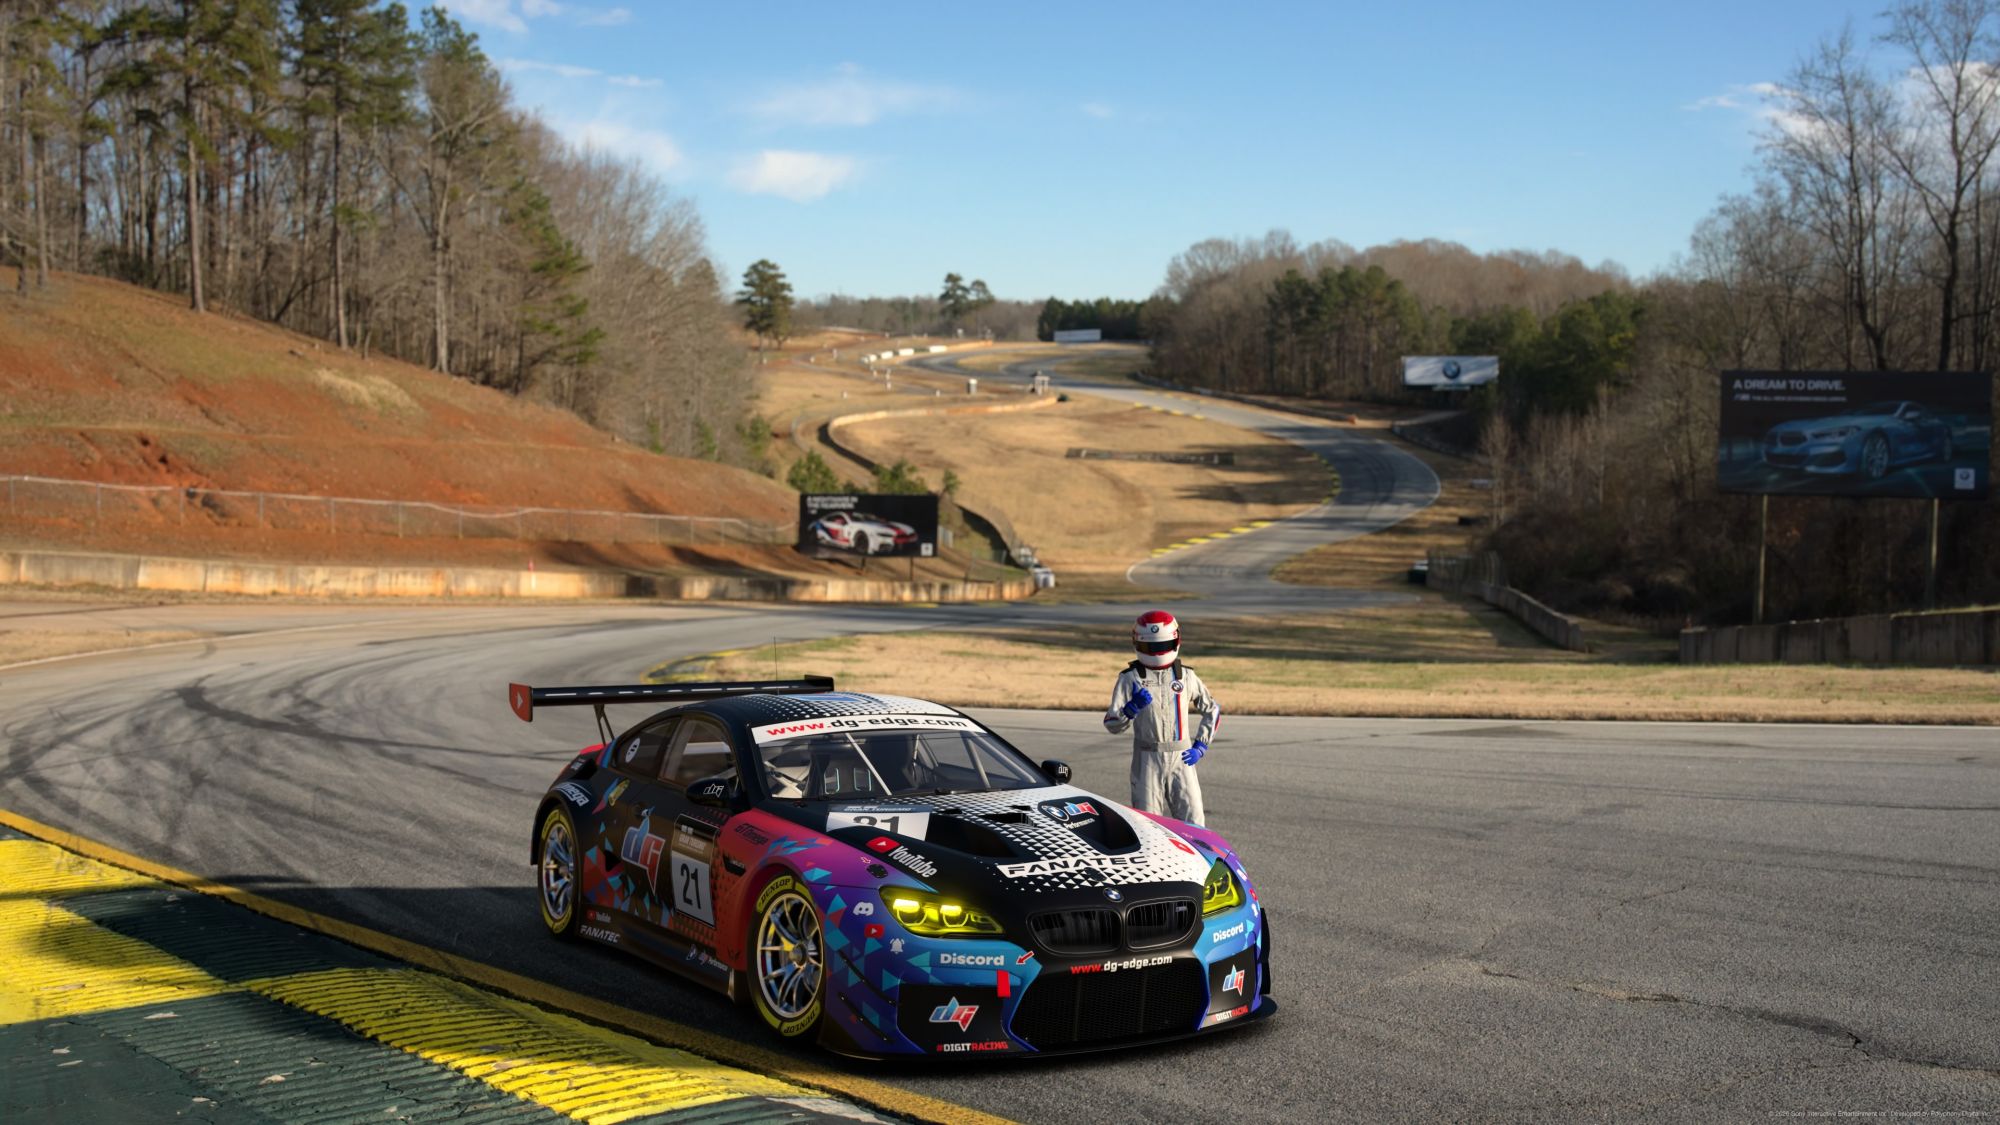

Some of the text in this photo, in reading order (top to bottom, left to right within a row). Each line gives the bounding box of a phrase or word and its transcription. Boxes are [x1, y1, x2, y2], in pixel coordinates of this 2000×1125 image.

[1733, 379, 1846, 390] A DREAM TO DRIVE.
[767, 717, 967, 736] www.dg-edge.com
[888, 845, 938, 878] YouTube
[1007, 855, 1149, 875] FANATEC
[680, 863, 702, 909] 21
[760, 879, 791, 903] DUNLOP
[580, 925, 620, 943] FANATEC
[1213, 923, 1243, 943] Discord
[940, 953, 1004, 966] Discord
[1070, 956, 1173, 974] www.dg-edge.com
[937, 1041, 1008, 1052] #DIGITRACING
